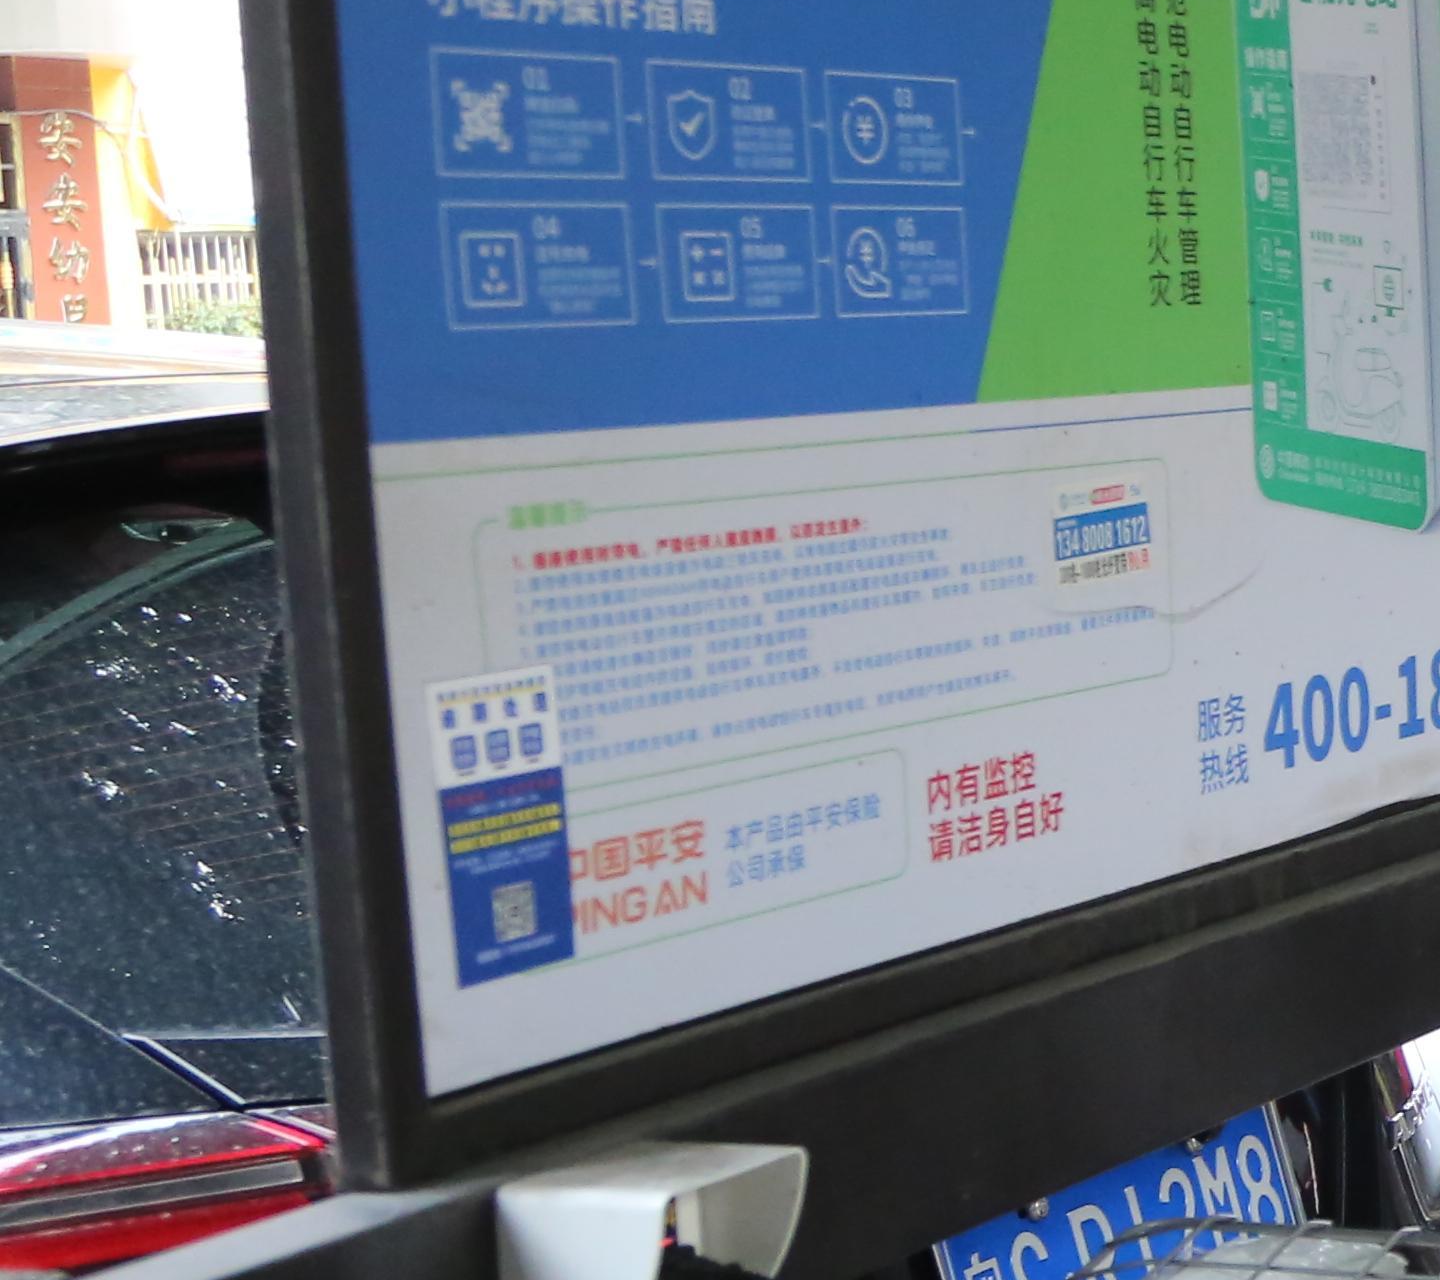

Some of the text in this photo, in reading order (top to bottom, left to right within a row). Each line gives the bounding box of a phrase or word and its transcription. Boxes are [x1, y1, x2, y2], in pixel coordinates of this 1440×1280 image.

[1198, 693, 1247, 743] 服务
[926, 751, 1037, 813] 内有监控
[1199, 744, 1250, 796] 热线
[725, 795, 882, 852] 本产品由平安保险
[928, 793, 1066, 863] 请洁身自好
[726, 846, 806, 891] 公司承保
[571, 882, 648, 936] ING
